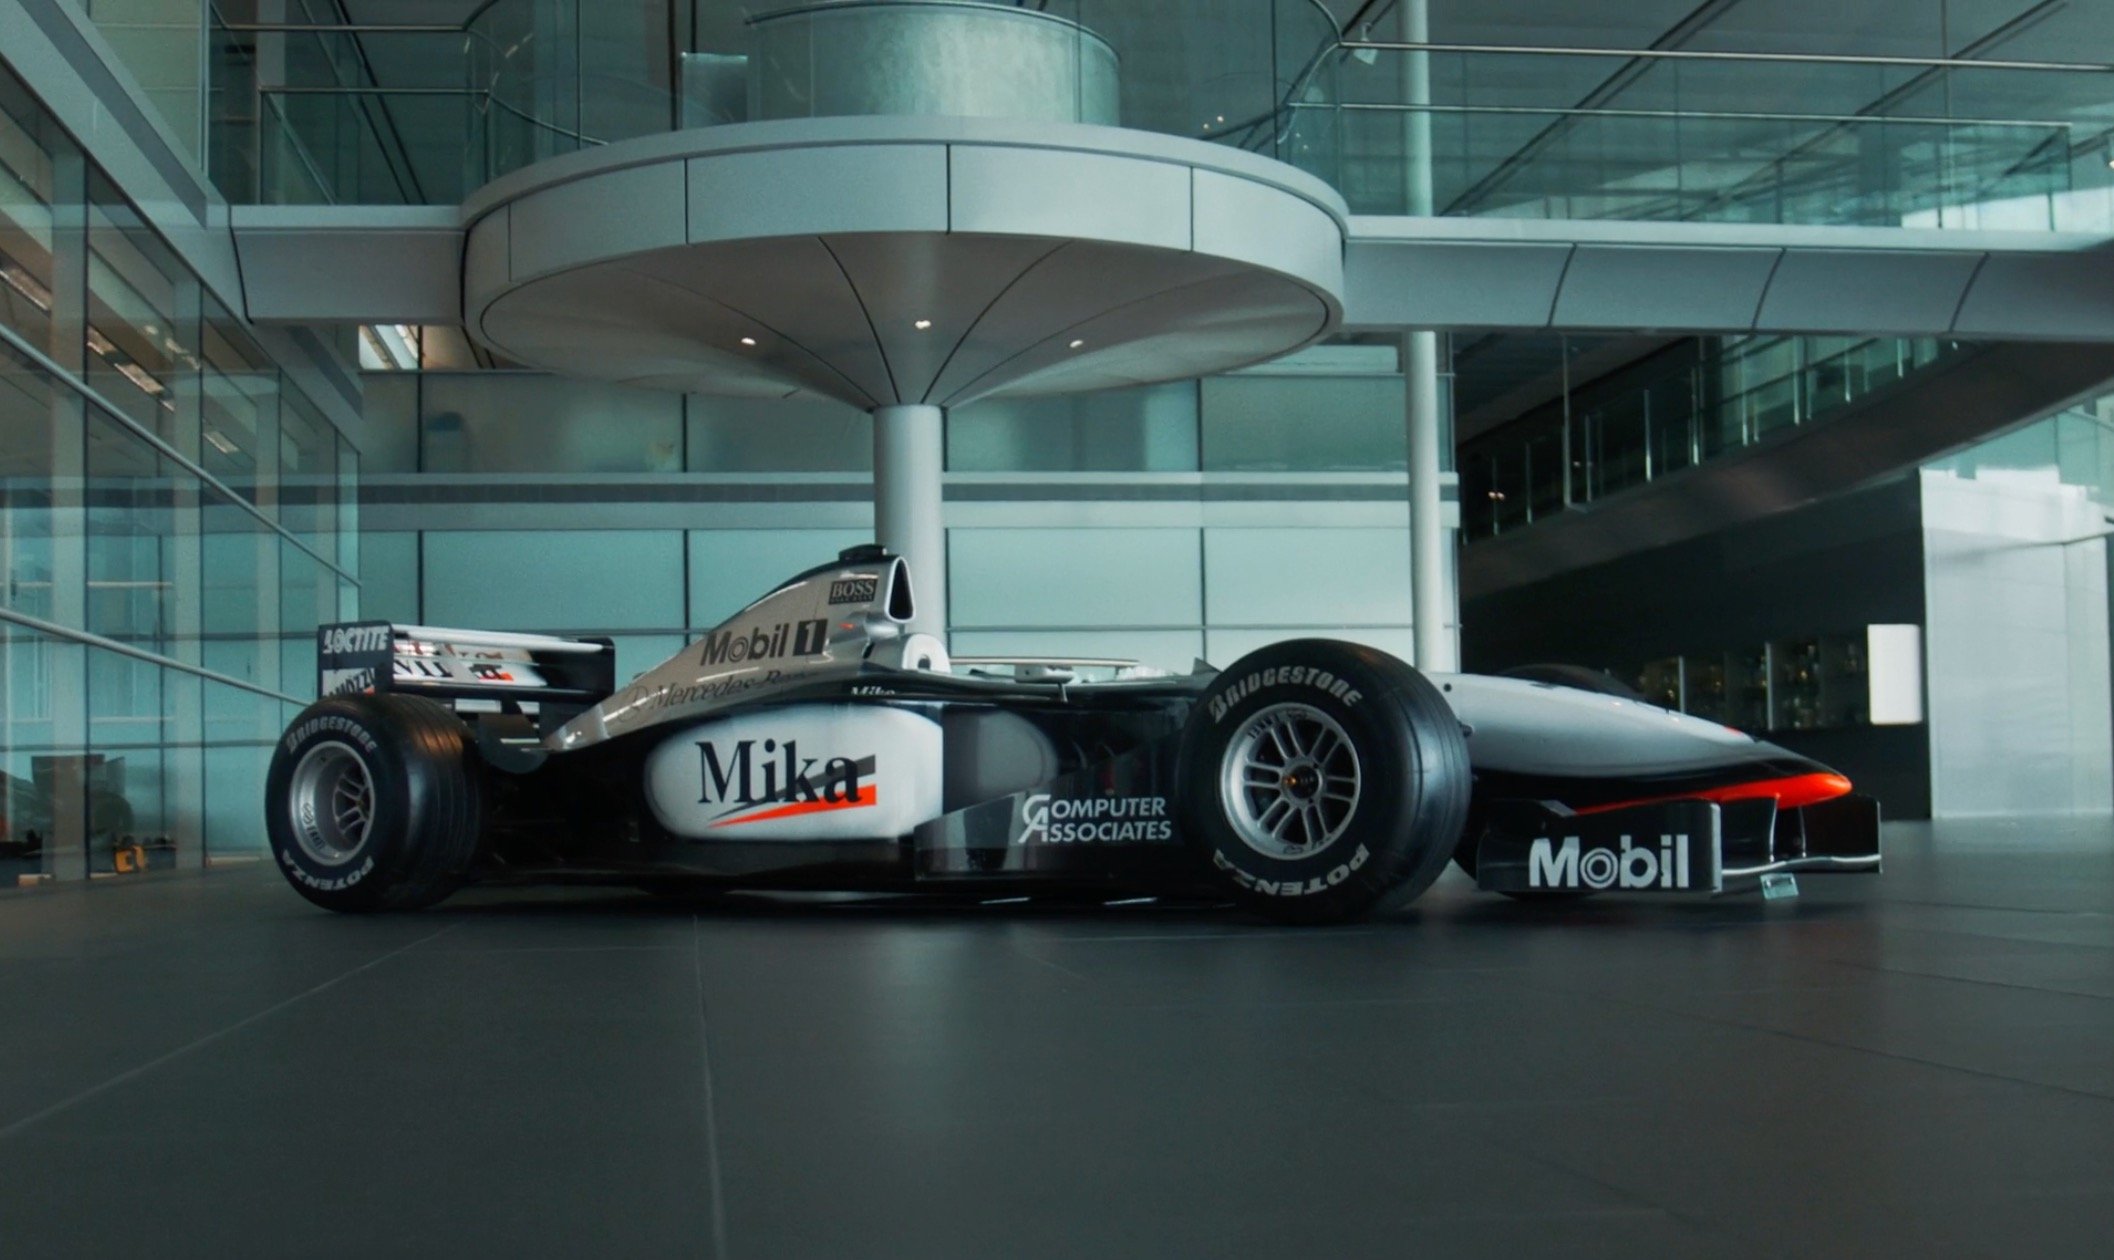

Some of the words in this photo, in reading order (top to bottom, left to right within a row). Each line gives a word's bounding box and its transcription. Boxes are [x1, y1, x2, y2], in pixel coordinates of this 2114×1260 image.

[832, 580, 874, 597] BOSS
[323, 626, 390, 654] LOCTITE
[700, 623, 789, 666] Mobil
[1207, 665, 1363, 724] BRIDGESTONE
[286, 716, 378, 754] BRIDGESTONE
[695, 738, 863, 804] Mika
[1018, 806, 1172, 844] ASSOCIATES
[1022, 794, 1166, 825] COMPUTER
[282, 848, 375, 891] POTENZA
[1212, 841, 1370, 898] POTENZA
[1529, 835, 1689, 888] Mobil
